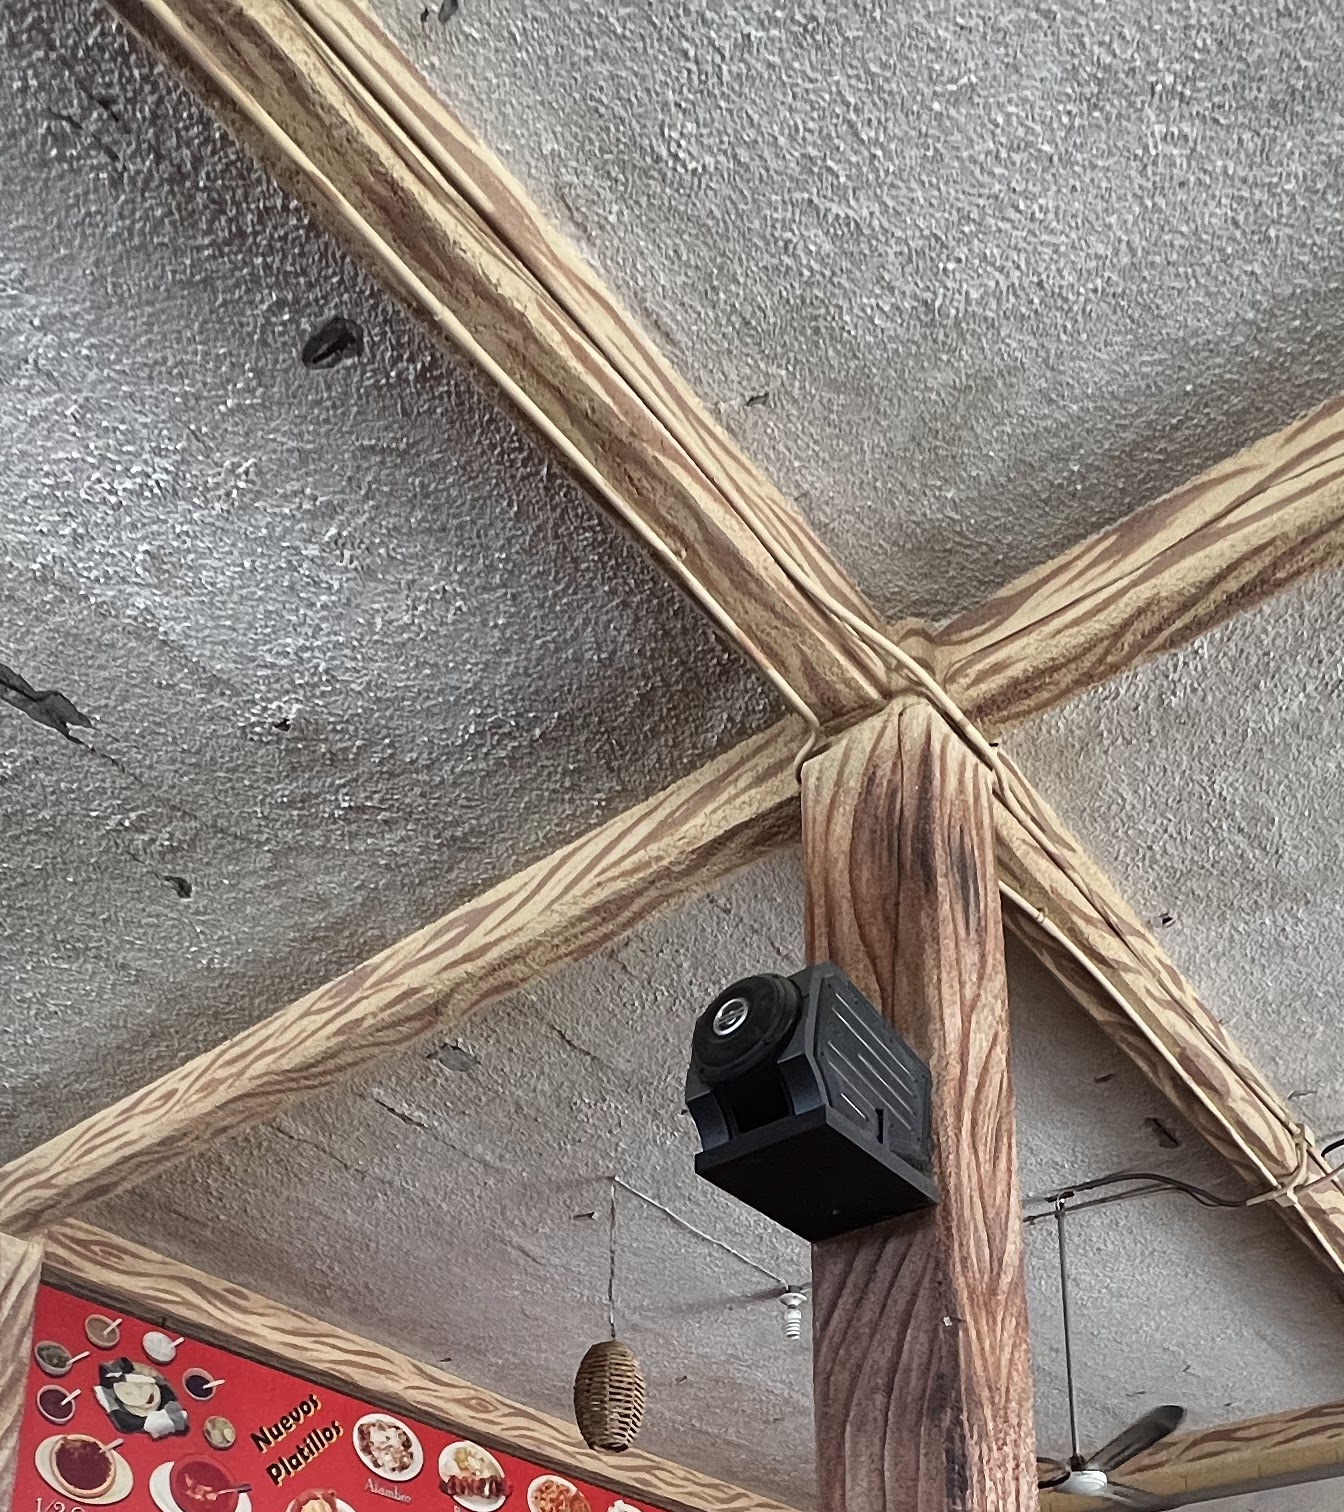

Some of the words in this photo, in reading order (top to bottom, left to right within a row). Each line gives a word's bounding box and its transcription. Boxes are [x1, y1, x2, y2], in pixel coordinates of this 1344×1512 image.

[250, 1393, 323, 1454] Nuevos
[265, 1420, 344, 1487] Platillos
[364, 1477, 413, 1504] Alambre
